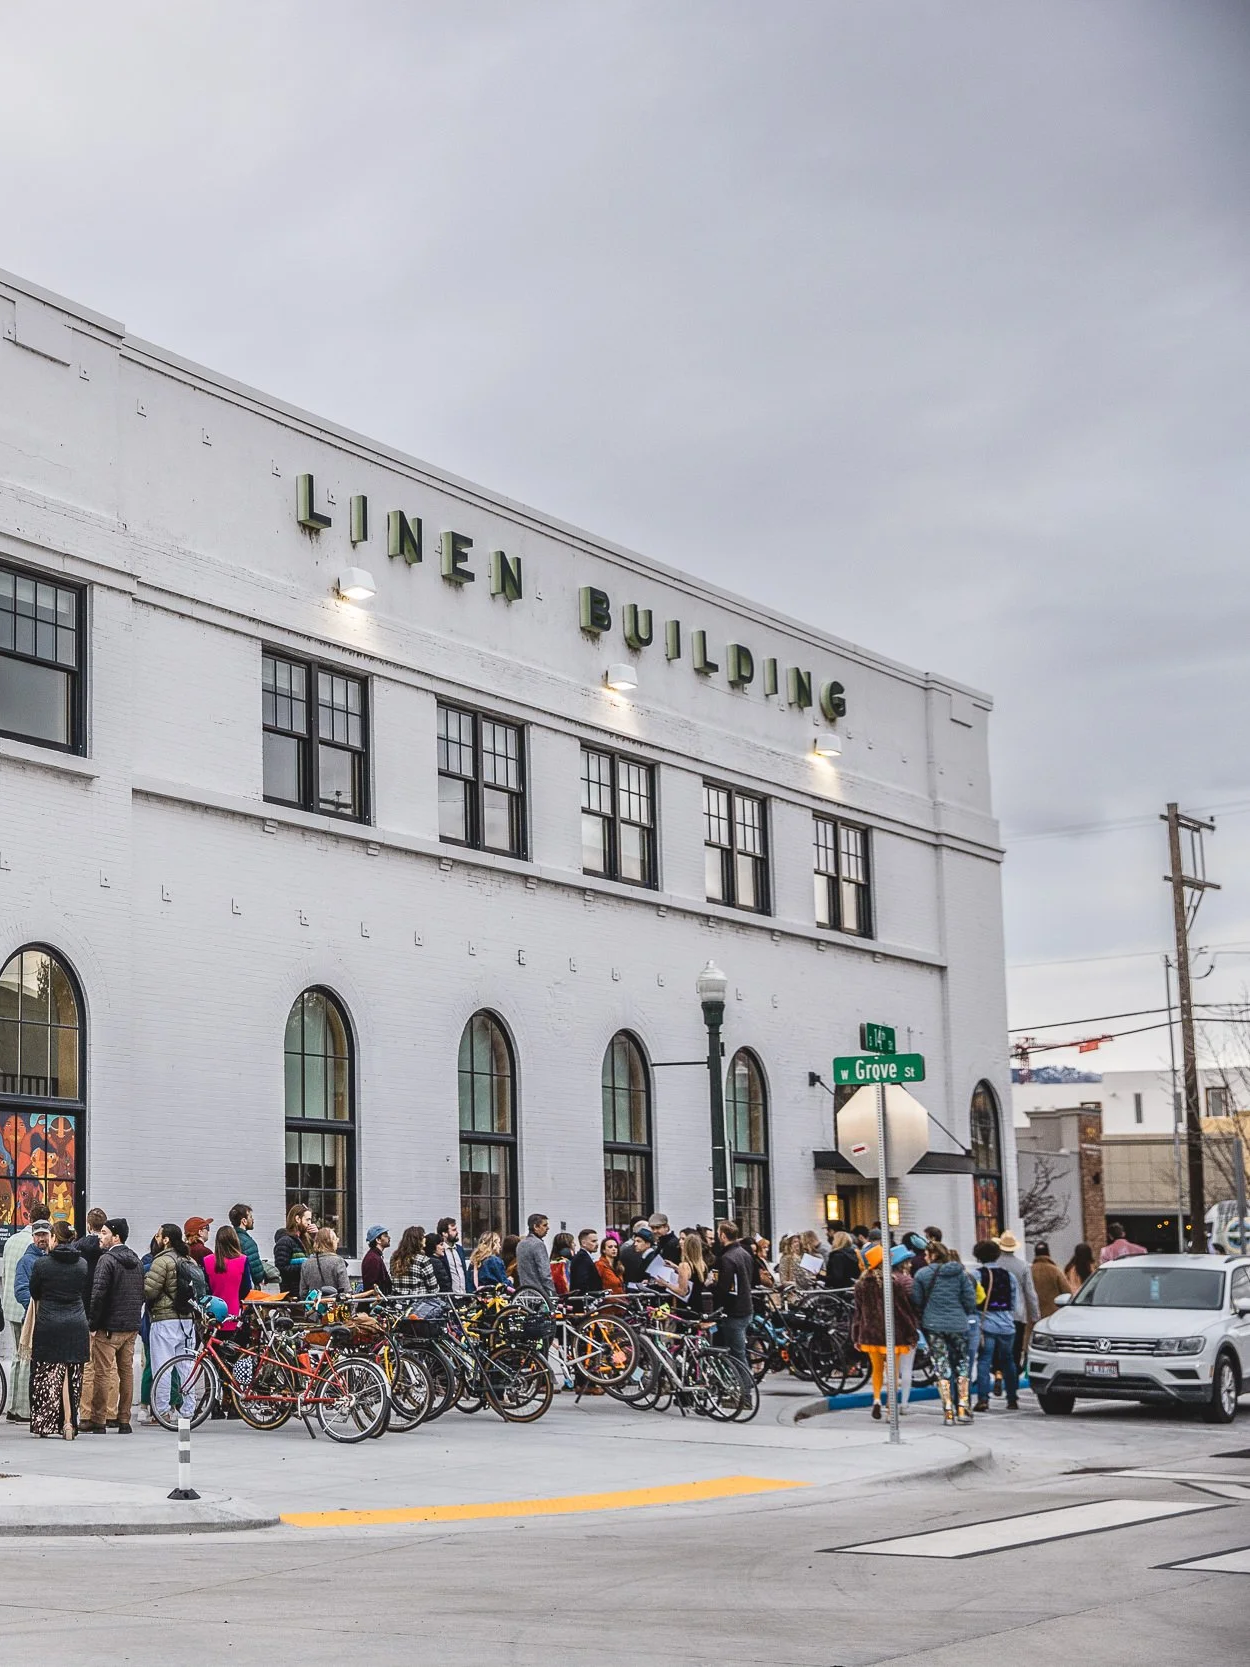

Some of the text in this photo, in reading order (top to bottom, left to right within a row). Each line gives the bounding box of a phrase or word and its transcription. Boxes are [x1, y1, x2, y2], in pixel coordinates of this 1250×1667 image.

[295, 472, 848, 721] LINEN BUILDING
[855, 1059, 898, 1081] Grove
[904, 1066, 915, 1078] St
